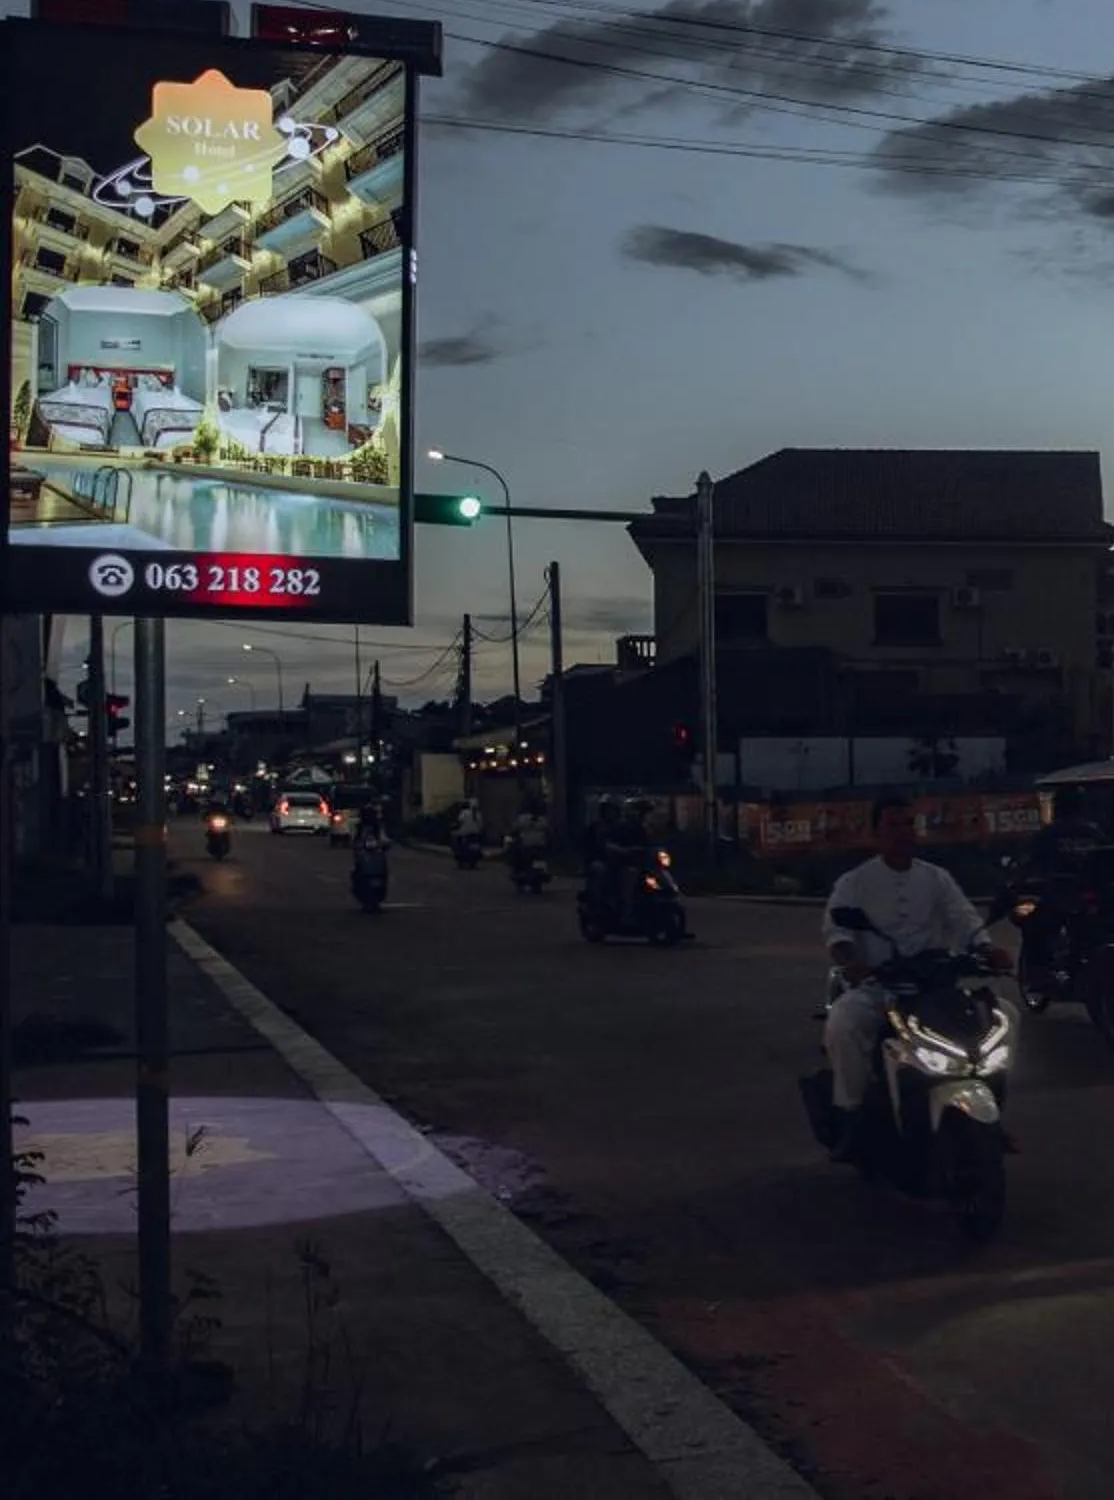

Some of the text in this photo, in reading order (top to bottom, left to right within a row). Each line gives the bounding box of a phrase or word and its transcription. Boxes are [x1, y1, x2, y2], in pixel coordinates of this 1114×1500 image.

[166, 115, 261, 141] SOLAR
[145, 563, 321, 595] 063 218 282
